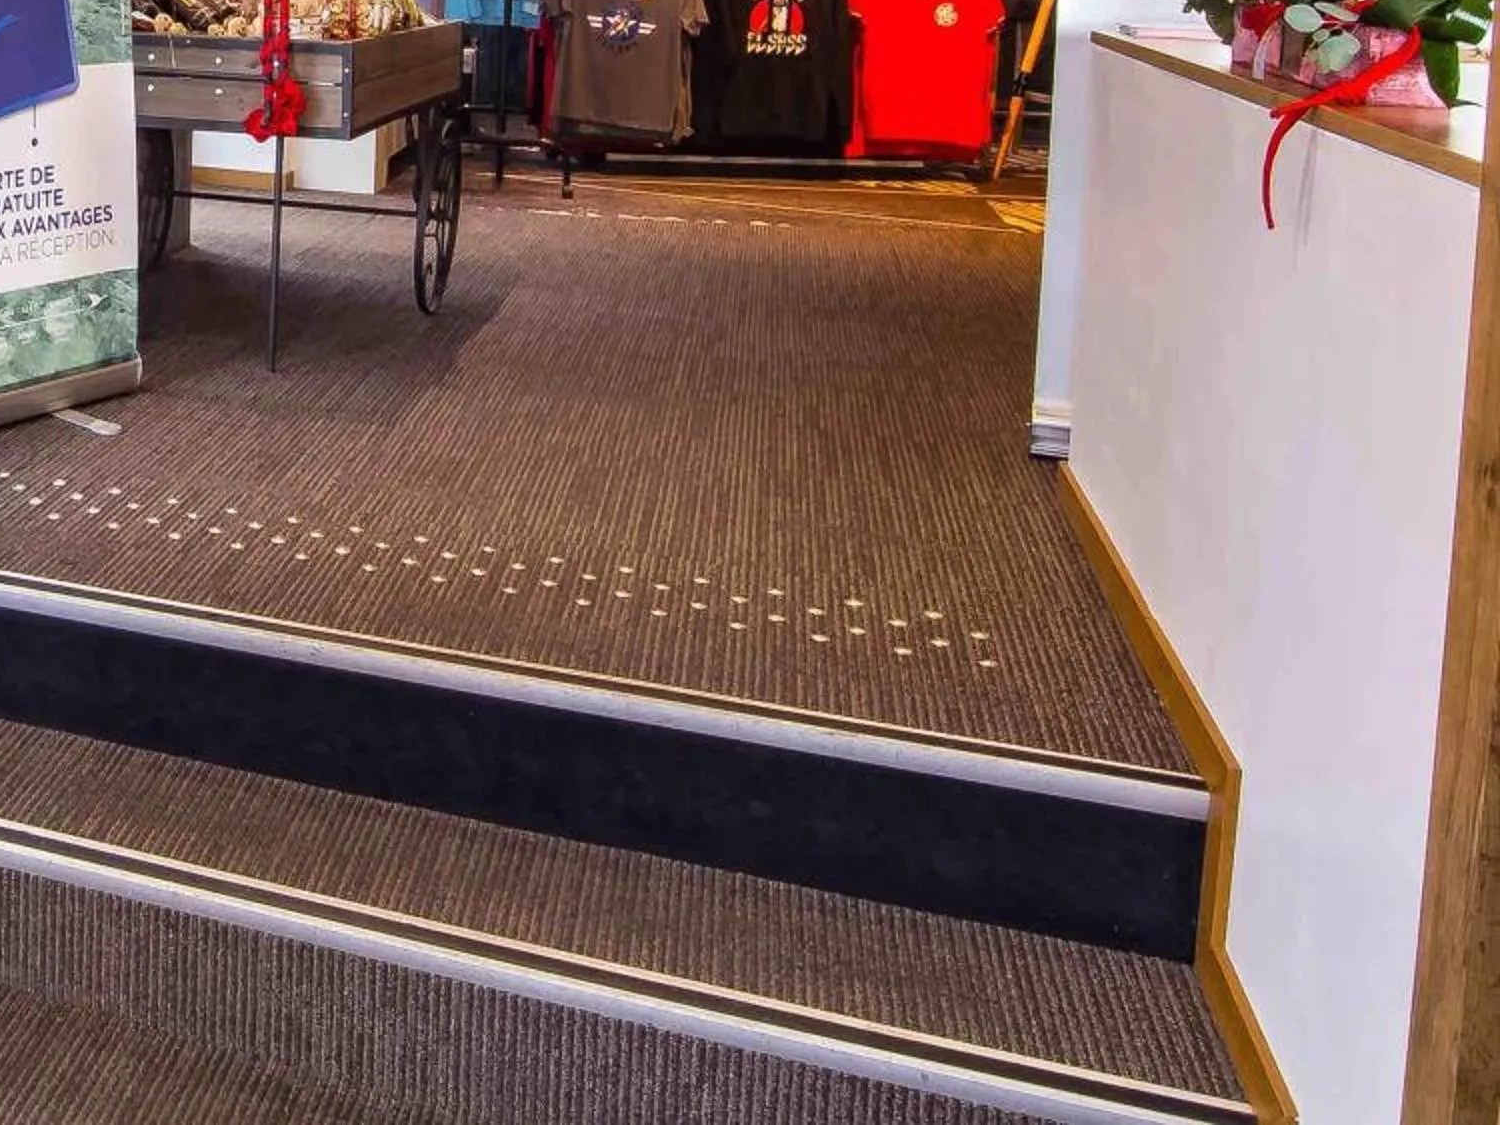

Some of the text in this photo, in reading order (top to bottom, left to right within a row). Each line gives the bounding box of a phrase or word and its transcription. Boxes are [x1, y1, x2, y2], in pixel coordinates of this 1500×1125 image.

[30, 165, 56, 185] DE
[11, 203, 115, 238] AVANTAGES
[17, 228, 116, 263] RÉCEPTION
